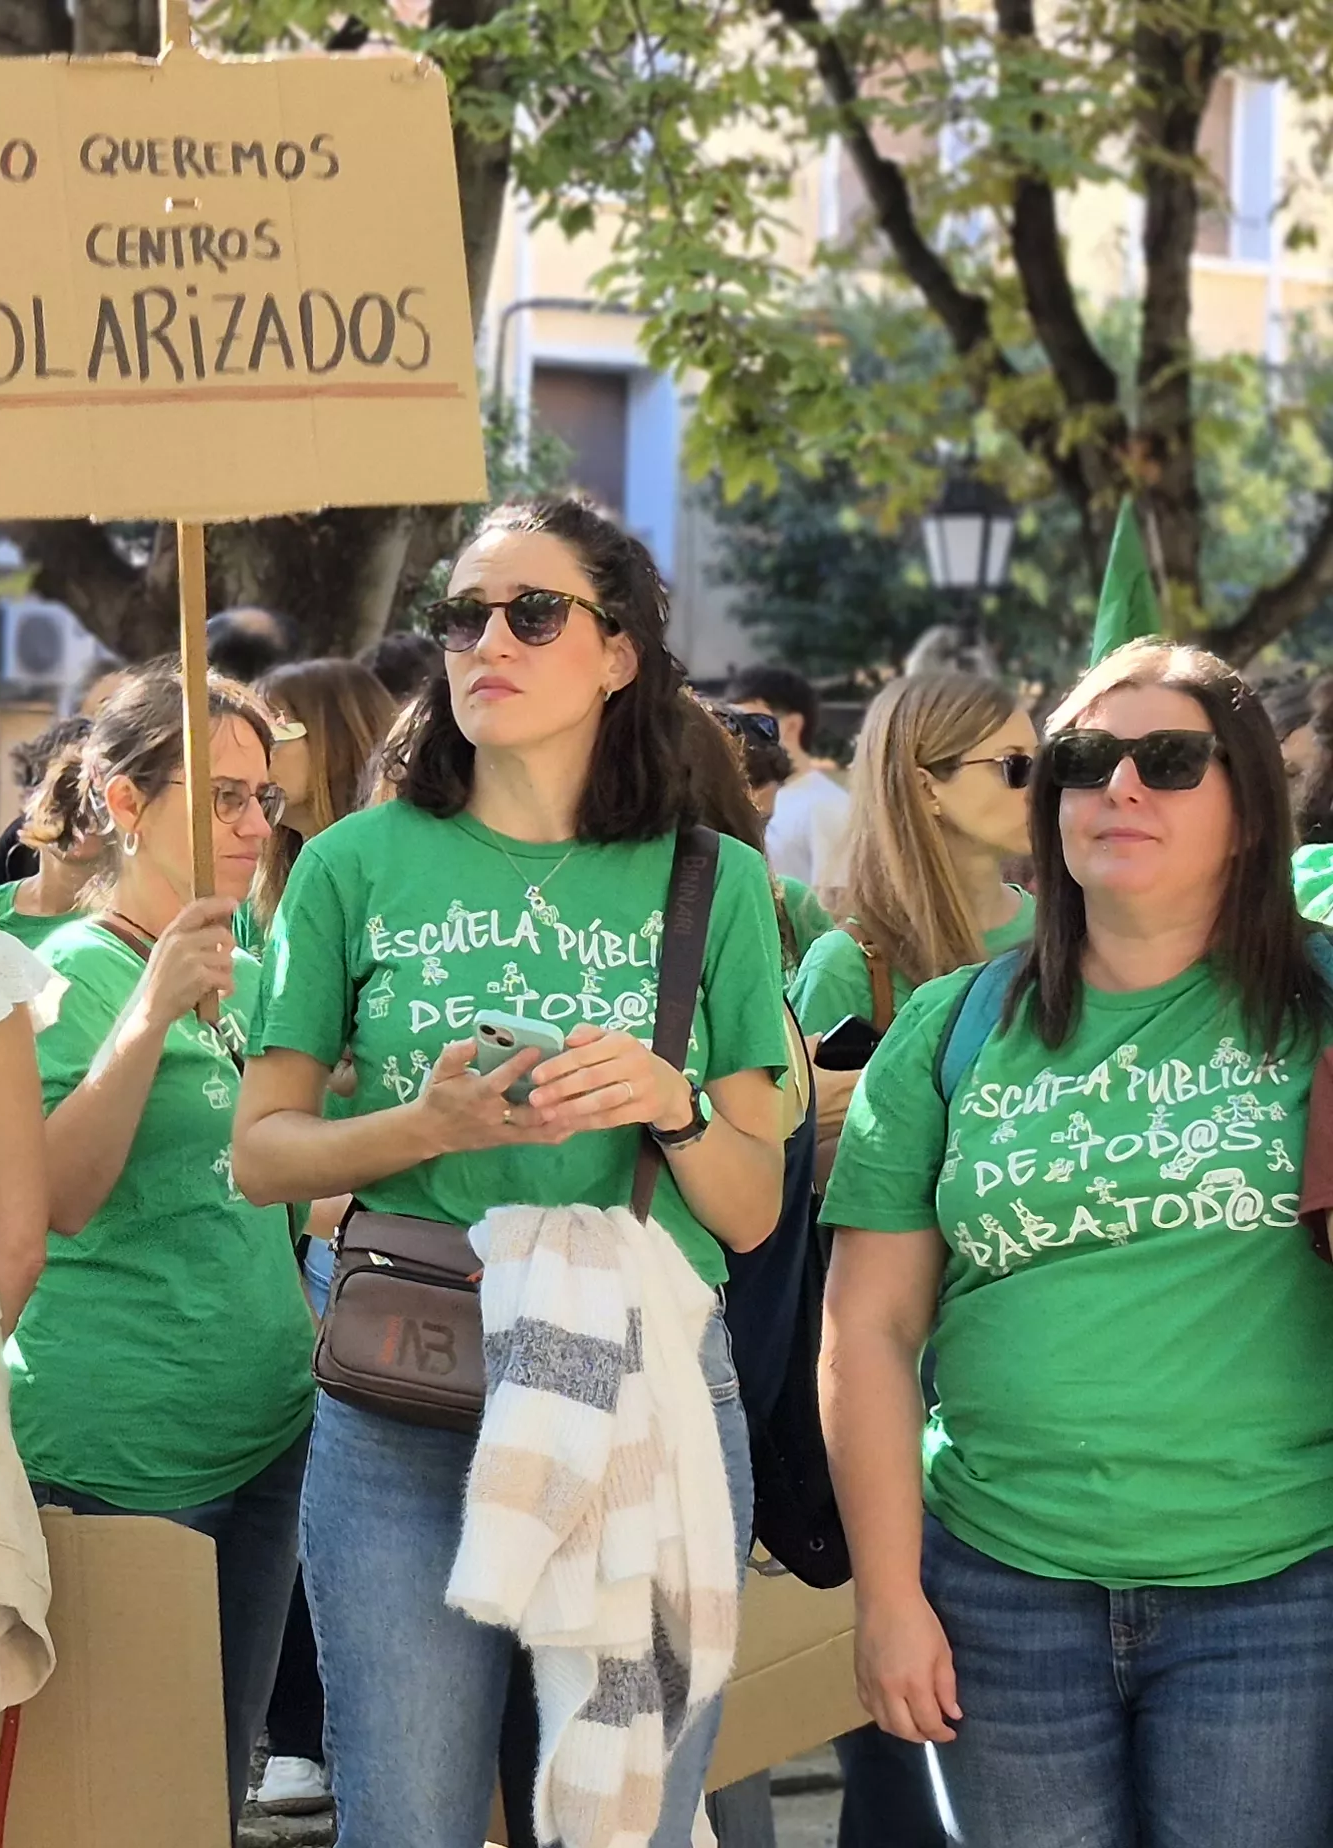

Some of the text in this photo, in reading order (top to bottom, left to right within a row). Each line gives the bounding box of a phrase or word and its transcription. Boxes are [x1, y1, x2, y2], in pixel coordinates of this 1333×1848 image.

[79, 132, 340, 181] QUEREMOS
[85, 218, 283, 274] CENTROS
[370, 909, 659, 971] ESCUELA PÚBLI
[408, 995, 476, 1034] DE
[974, 1119, 1263, 1198] DE TOD@S
[1113, 1186, 1301, 1232] TOD@S
